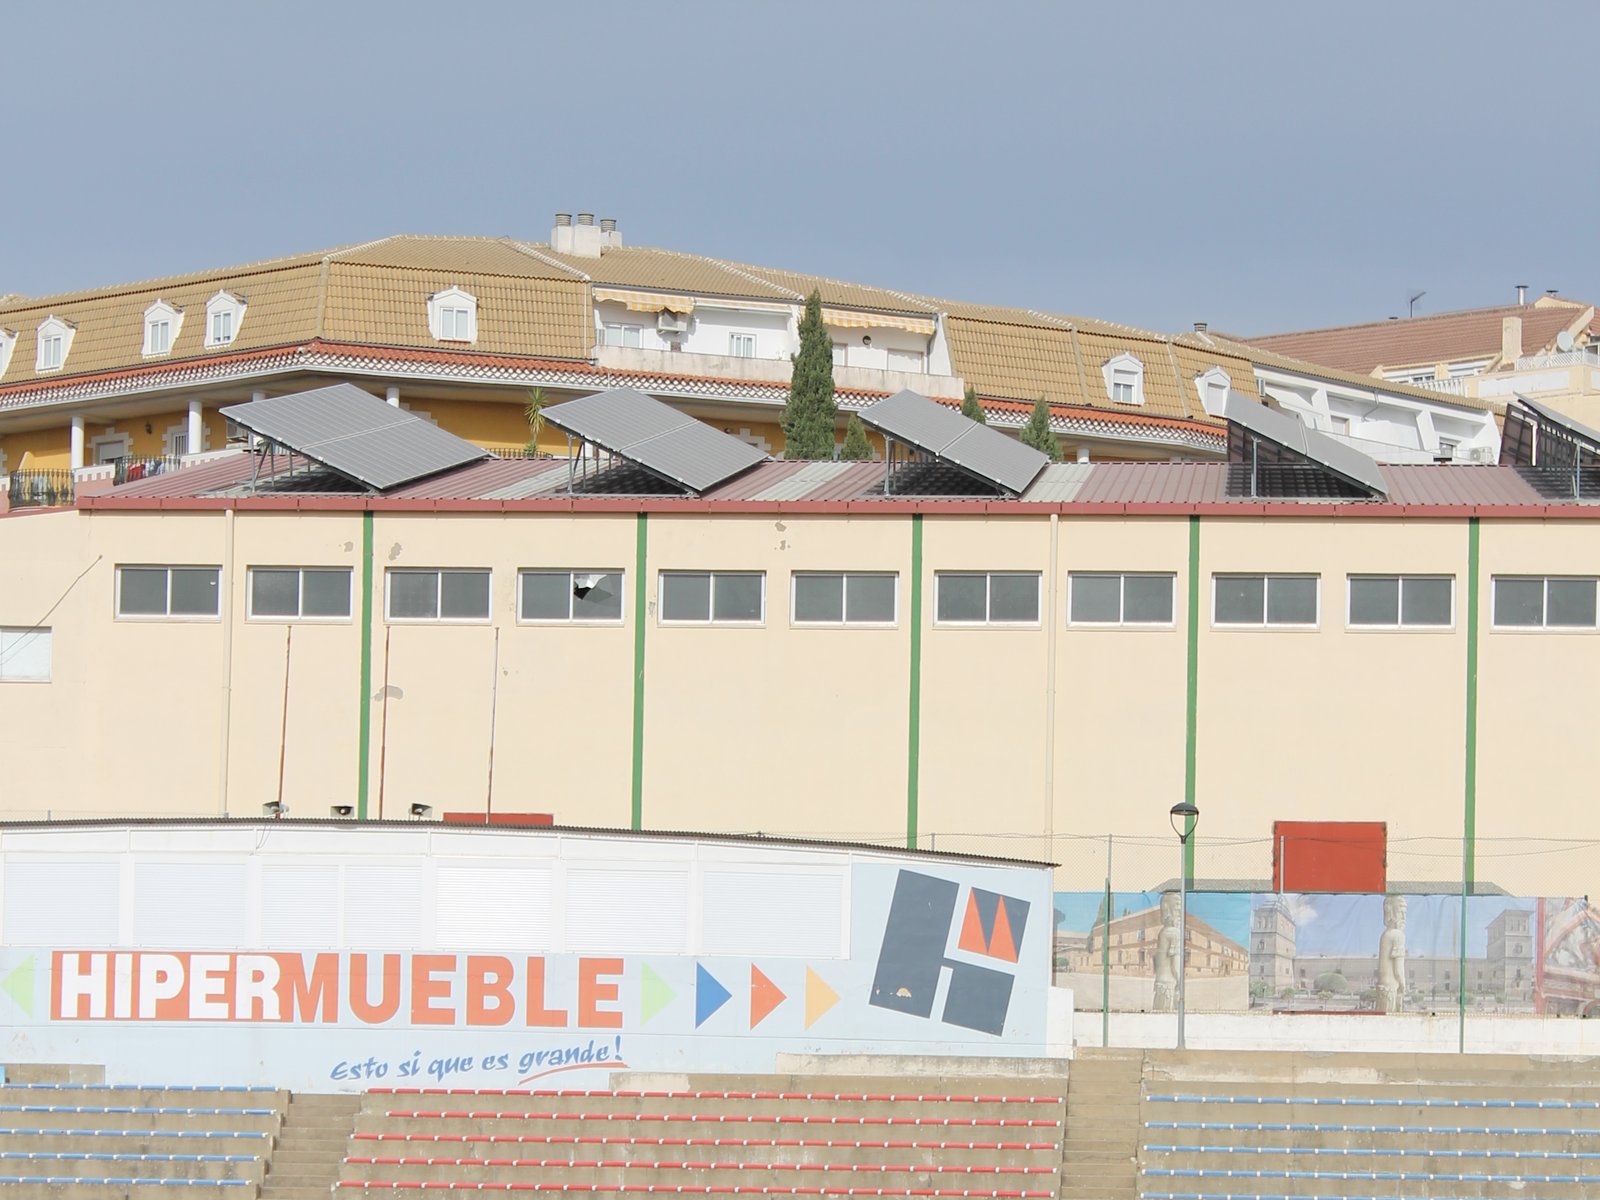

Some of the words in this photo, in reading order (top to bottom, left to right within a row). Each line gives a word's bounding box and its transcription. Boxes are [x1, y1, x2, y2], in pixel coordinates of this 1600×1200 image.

[59, 952, 624, 1029] HIPERMUEBLE
[329, 1056, 389, 1081] Esto
[396, 1050, 422, 1079] si
[427, 1052, 474, 1082] que
[481, 1052, 509, 1071] es
[517, 1035, 623, 1075] grande!
